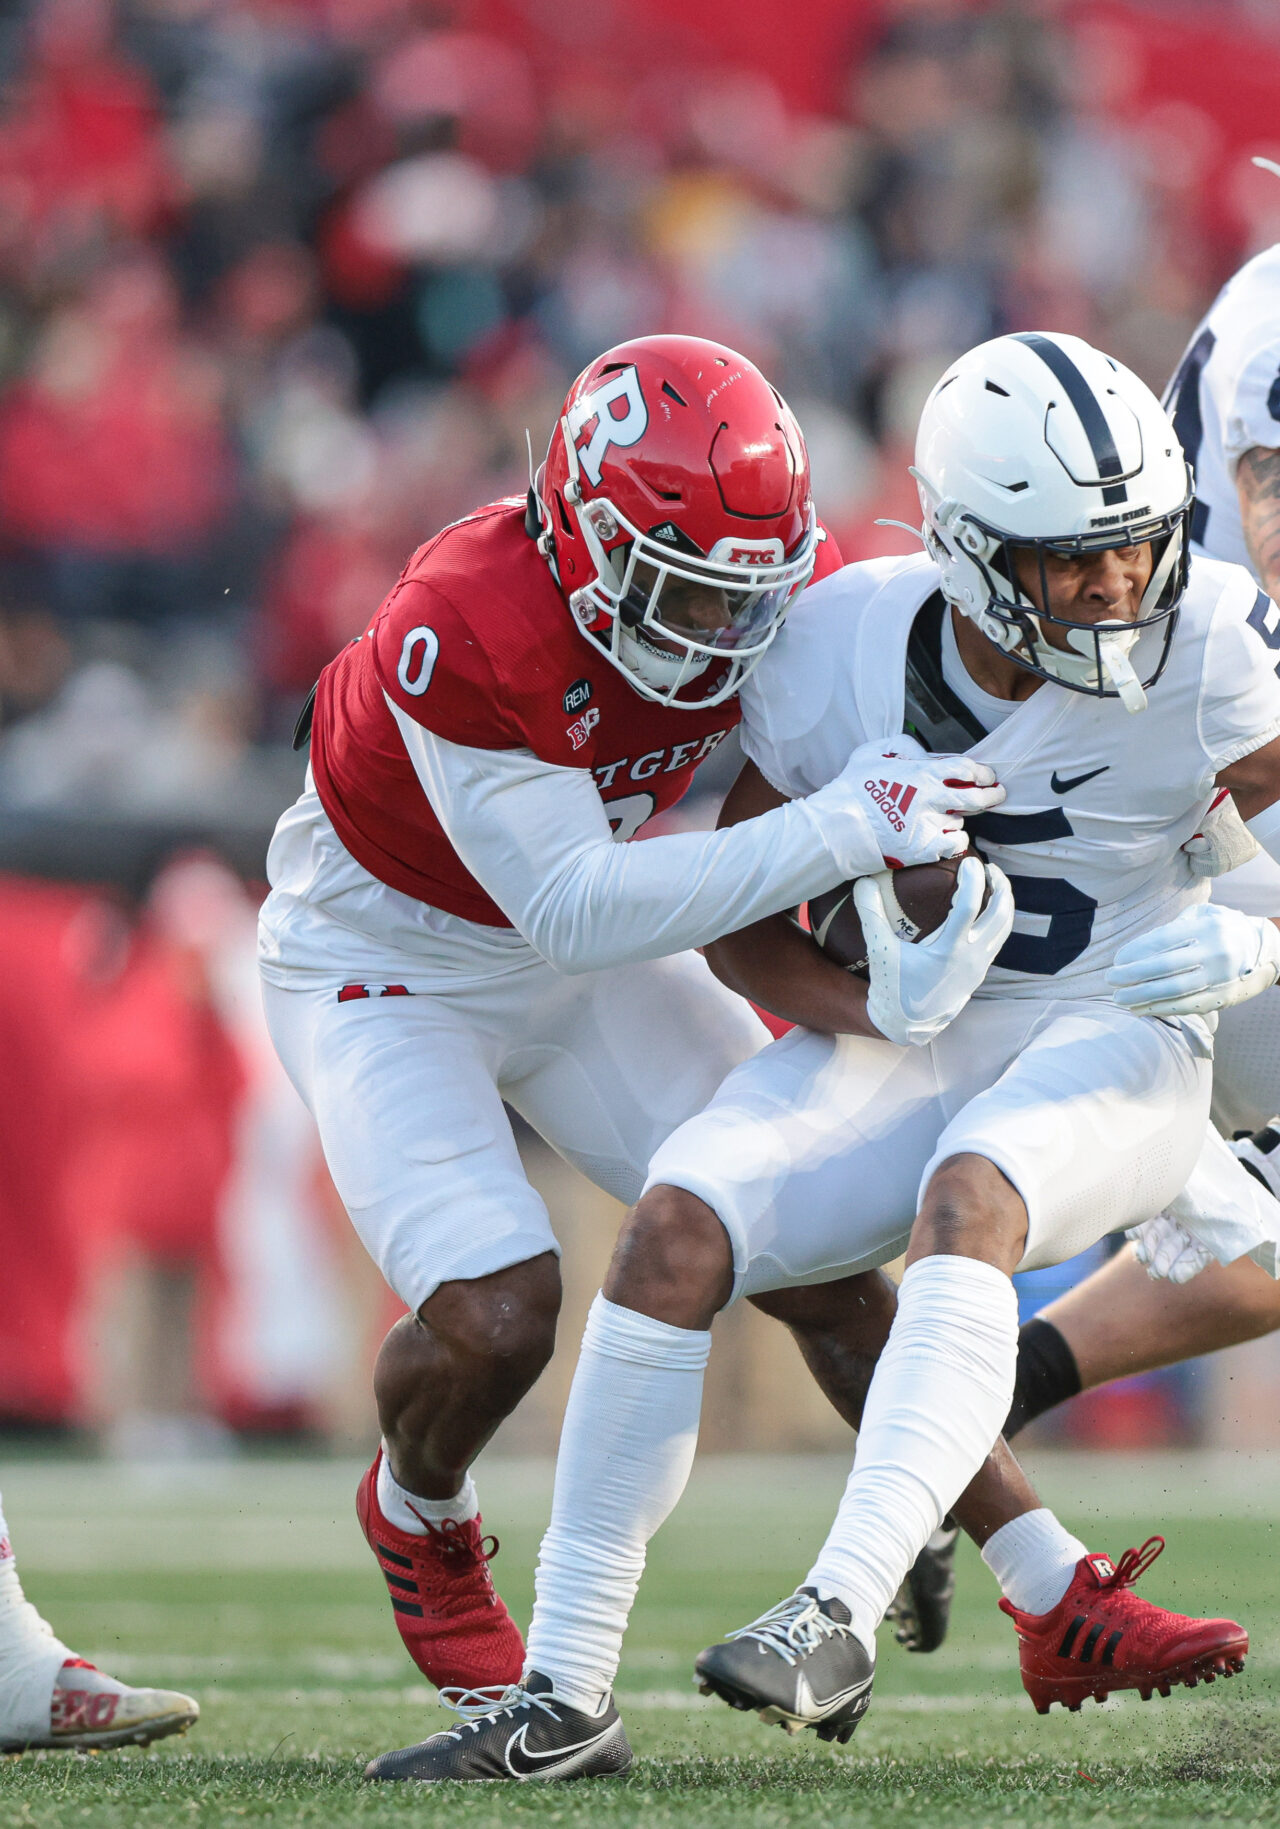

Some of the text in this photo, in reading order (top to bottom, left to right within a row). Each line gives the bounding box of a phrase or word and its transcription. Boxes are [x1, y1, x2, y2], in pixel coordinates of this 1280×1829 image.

[566, 365, 649, 488] R
[1090, 505, 1152, 528] PENN STATE
[728, 547, 776, 564] FTG
[397, 625, 440, 697] 0
[565, 682, 590, 712] REM
[595, 729, 727, 790] TGER
[864, 779, 906, 833] adidas
[1091, 1558, 1116, 1579] R
